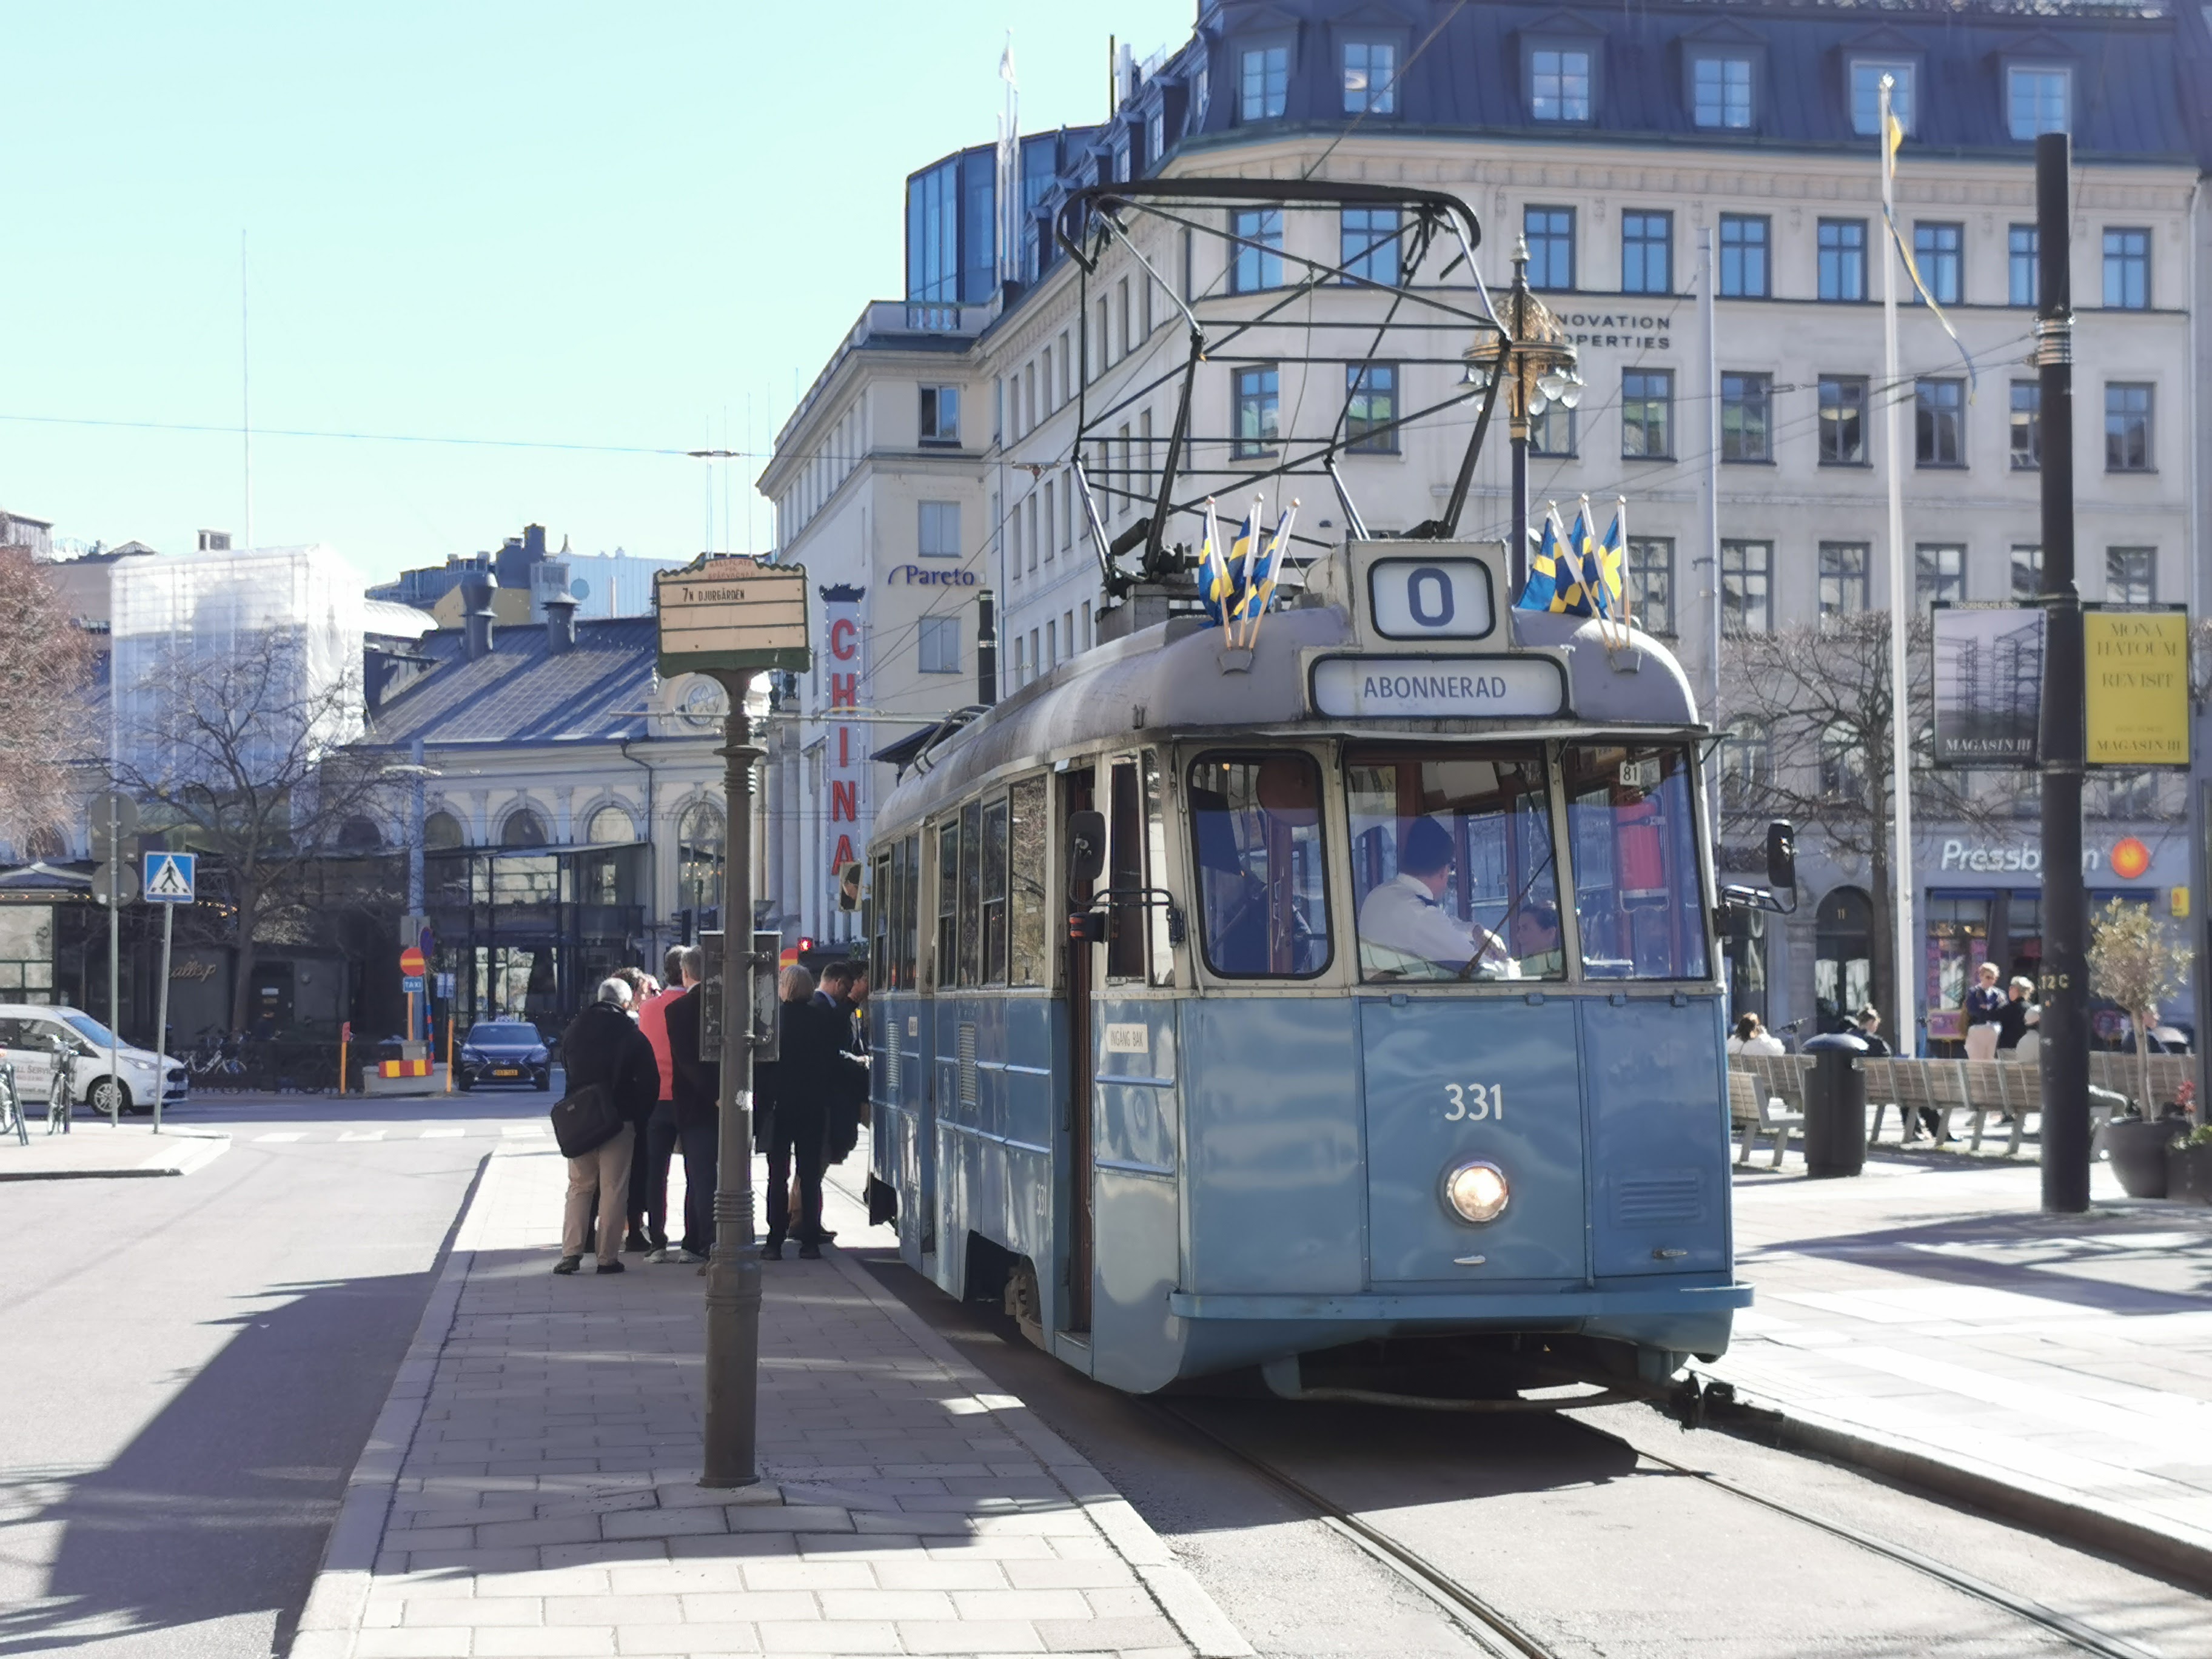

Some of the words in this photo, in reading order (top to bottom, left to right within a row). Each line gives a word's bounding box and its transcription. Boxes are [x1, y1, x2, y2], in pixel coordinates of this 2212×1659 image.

[1556, 314, 1670, 329] NOVATION
[888, 565, 975, 586] Pareto
[698, 588, 745, 602] DJURGÅRDEN
[2111, 623, 2163, 637] MONA
[2097, 642, 2177, 656] HATOUM
[1364, 676, 1506, 698] ABONNERAD
[831, 618, 856, 876] CHINA
[1946, 739, 2014, 751] MAGASIN
[2017, 739, 2031, 751] III
[2097, 740, 2163, 751] MAGASIN
[1623, 766, 1637, 781] 81
[1942, 840, 2099, 876] Pressbn
[2039, 975, 2056, 989] 12
[1444, 1084, 1502, 1121] 331
[1037, 1184, 1047, 1216] 331
